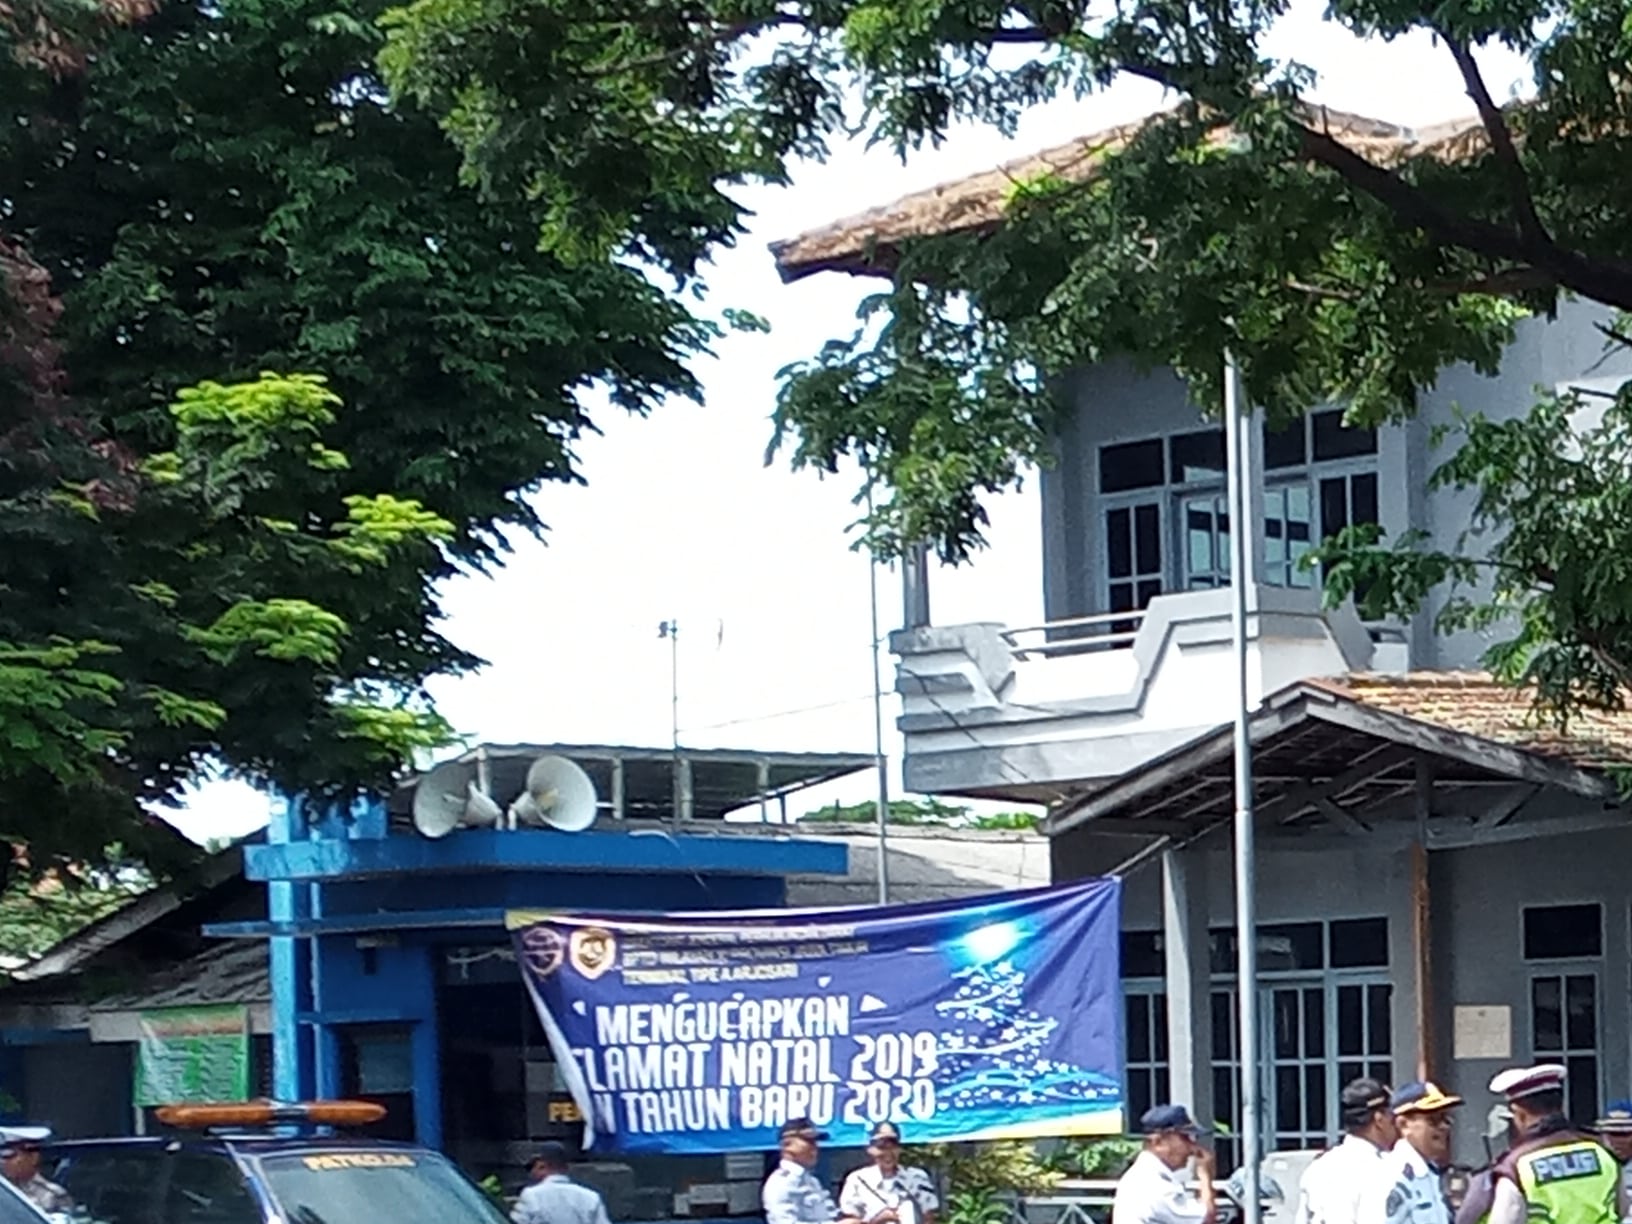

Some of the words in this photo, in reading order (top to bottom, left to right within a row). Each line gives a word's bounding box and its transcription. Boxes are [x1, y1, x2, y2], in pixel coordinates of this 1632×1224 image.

[595, 994, 849, 1046] MENGUCAPKAN
[721, 1036, 841, 1087] NATAL
[851, 1030, 939, 1081] 2019
[620, 1086, 731, 1134] TAHUN
[741, 1082, 835, 1129] BARU
[844, 1077, 936, 1125] 2020
